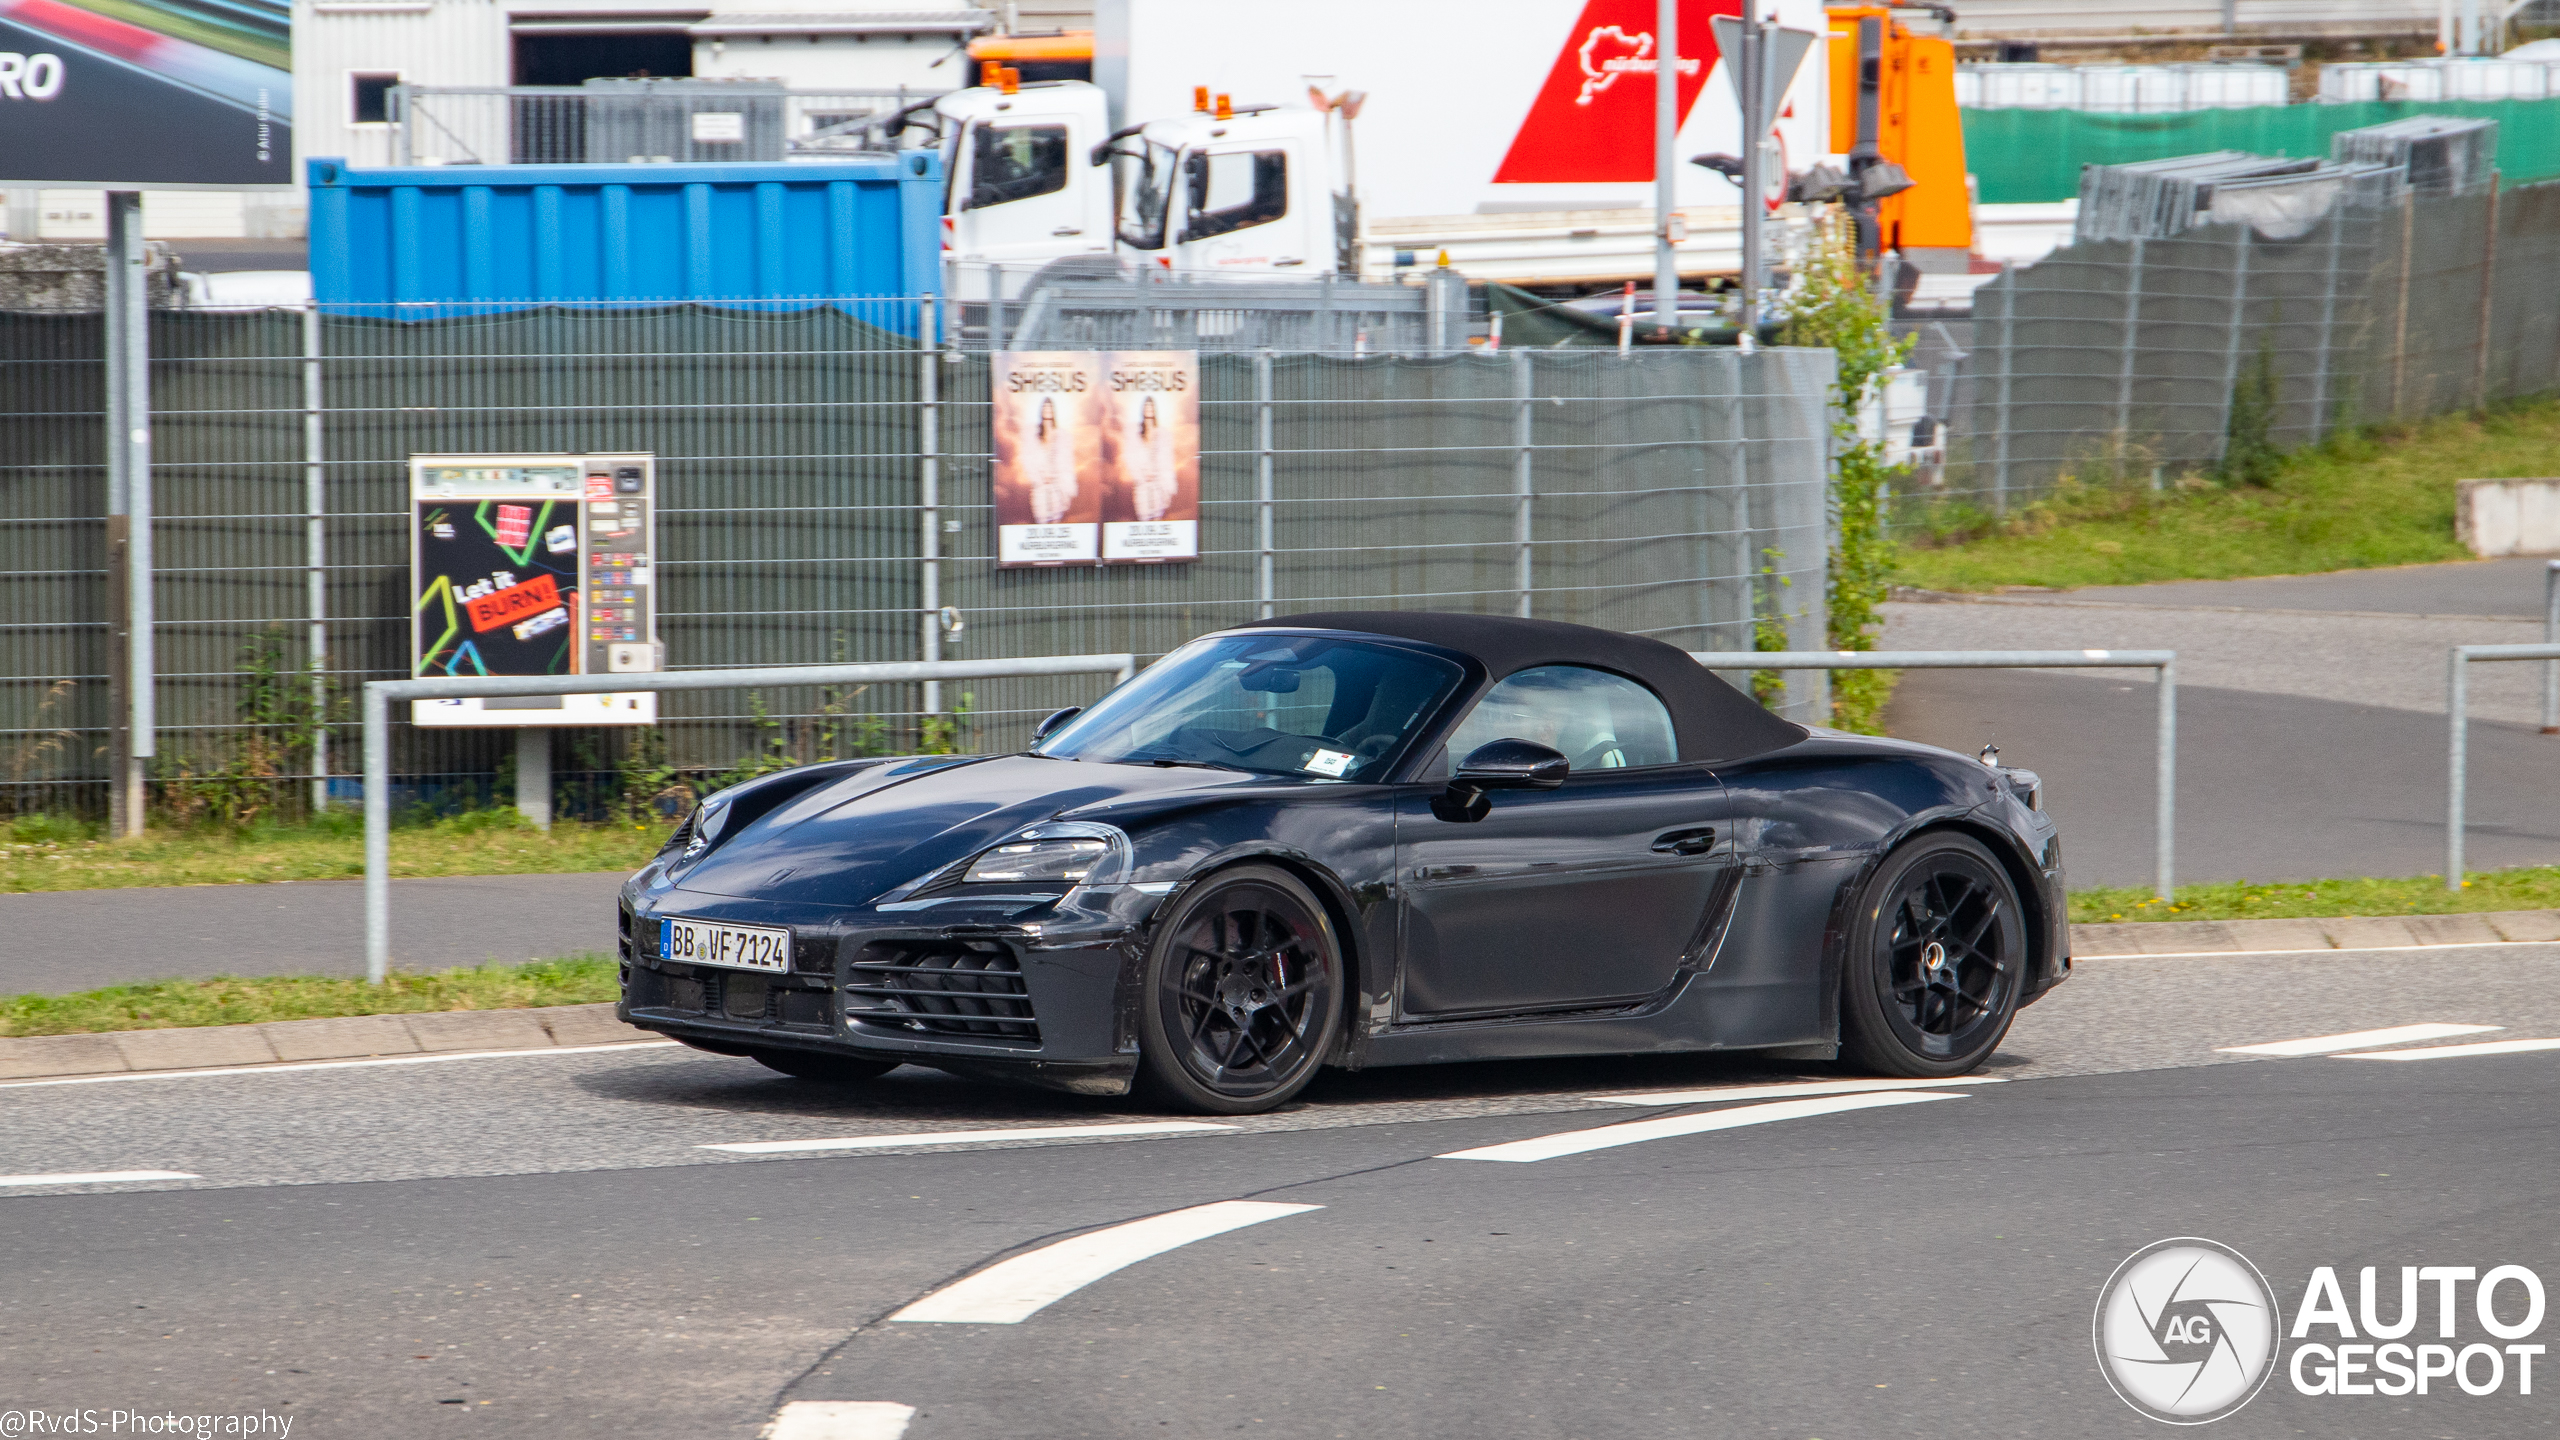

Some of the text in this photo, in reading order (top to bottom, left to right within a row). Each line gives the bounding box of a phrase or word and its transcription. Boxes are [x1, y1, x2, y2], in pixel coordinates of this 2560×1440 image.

[452, 571, 517, 603] Let it
[478, 582, 553, 621] BURN!
[673, 925, 784, 968] BB VF 7124
[1276, 952, 1286, 990] PORSCH
